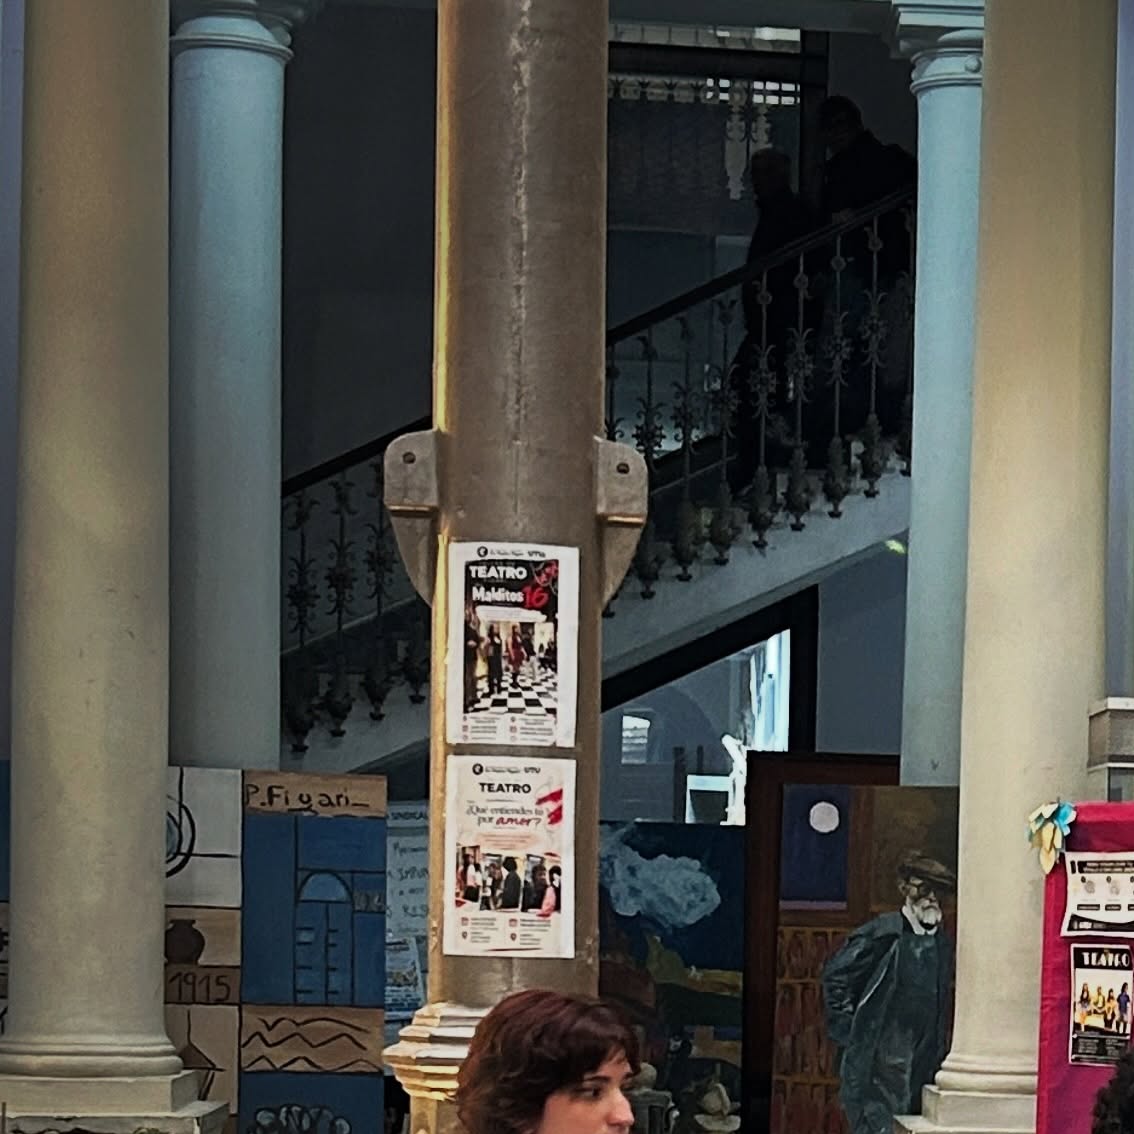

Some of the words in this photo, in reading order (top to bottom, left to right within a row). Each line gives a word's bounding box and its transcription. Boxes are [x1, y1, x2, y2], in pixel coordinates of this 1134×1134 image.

[469, 565, 528, 579] TEATRO
[472, 586, 524, 602] Malditos
[523, 586, 549, 608] 16
[478, 782, 532, 794] TEATRO
[477, 816, 494, 826] por
[1082, 952, 1130, 967] TEATRO
[168, 971, 231, 1003] 1915
